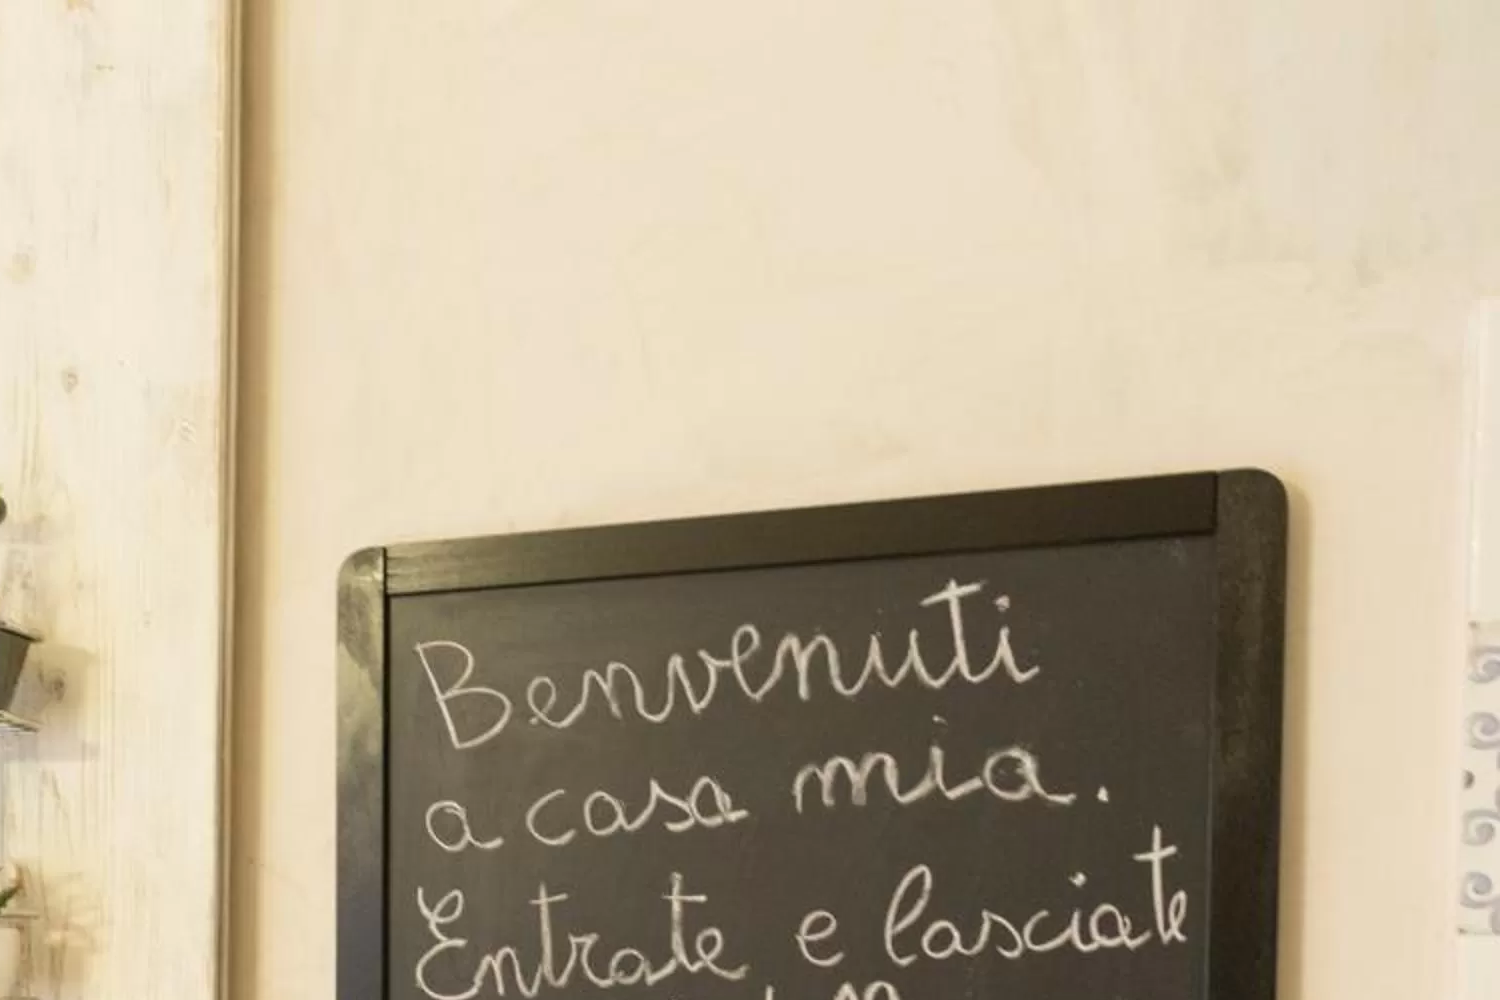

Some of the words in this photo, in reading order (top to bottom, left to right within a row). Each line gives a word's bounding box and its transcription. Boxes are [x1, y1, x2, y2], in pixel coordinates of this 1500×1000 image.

[415, 579, 1040, 749] Benvenuti
[425, 800, 504, 852] a
[526, 775, 749, 846] casa
[795, 909, 845, 967] e
[883, 825, 1188, 967] lasciate
